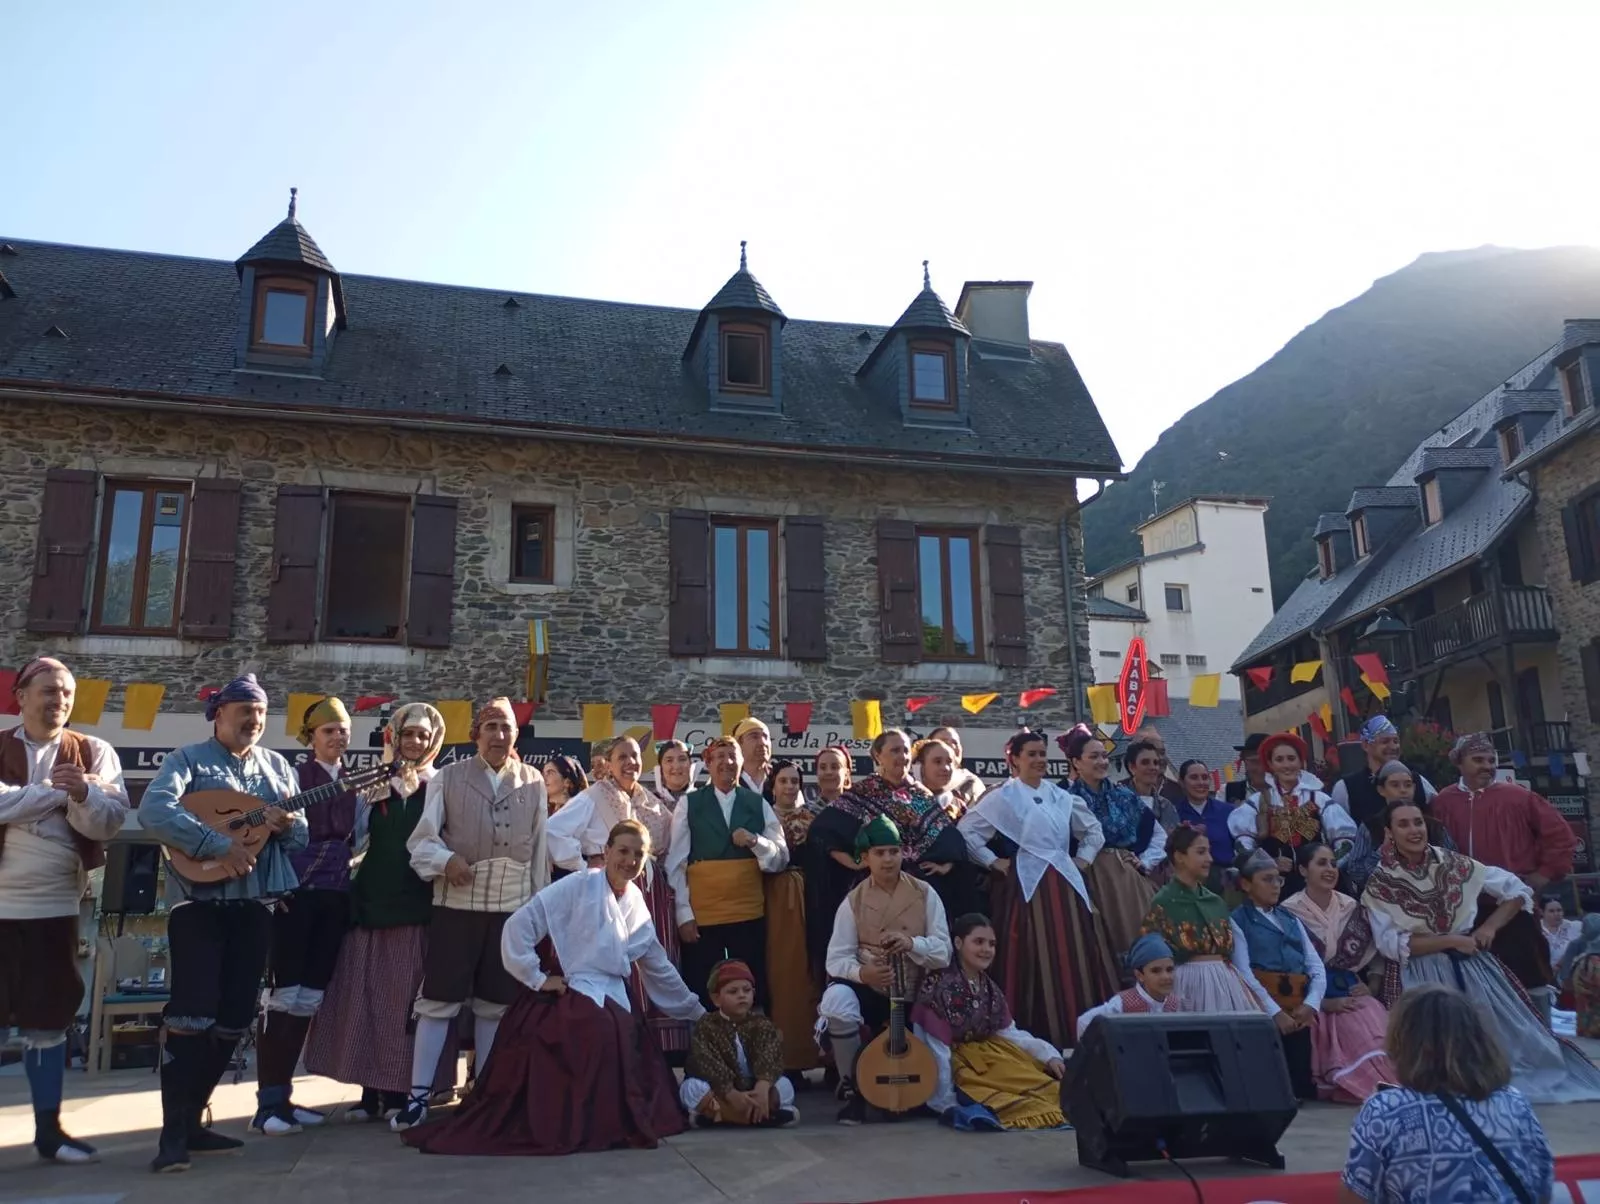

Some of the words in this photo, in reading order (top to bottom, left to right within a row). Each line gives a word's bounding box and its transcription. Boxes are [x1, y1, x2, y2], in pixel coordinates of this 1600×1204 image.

[1127, 657, 1140, 715] TABAC
[803, 731, 819, 749] la
[825, 731, 872, 749] Press
